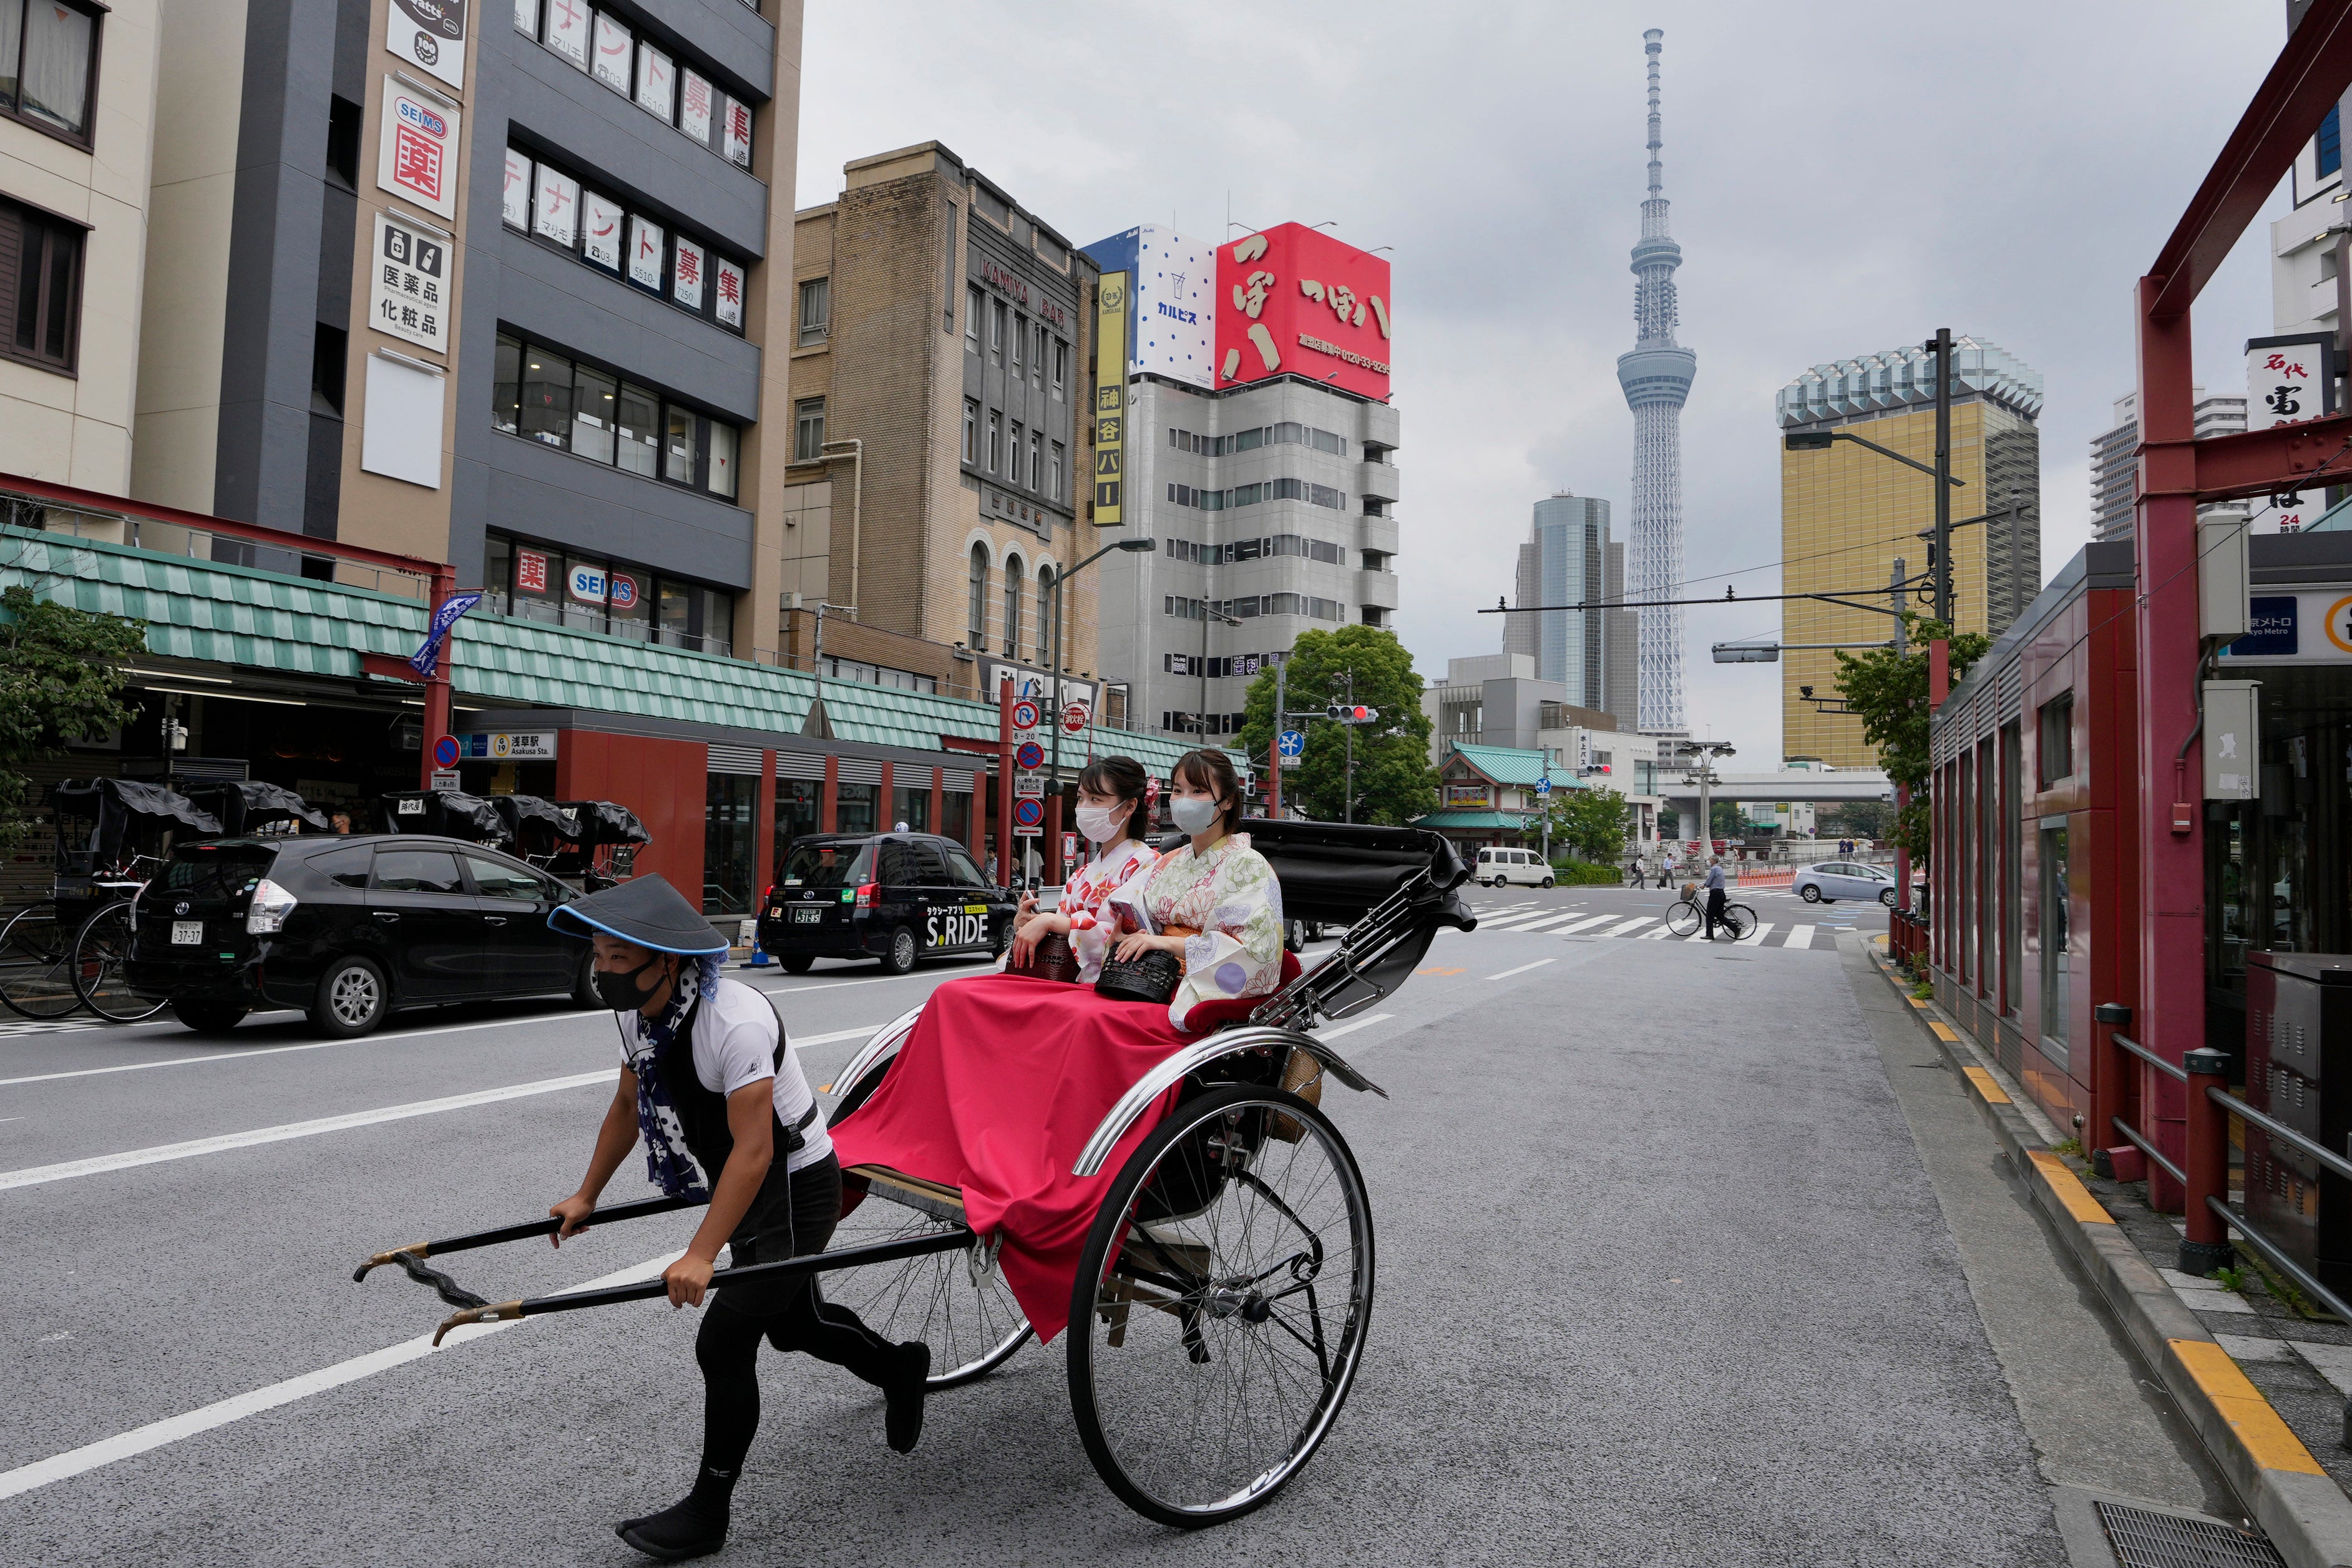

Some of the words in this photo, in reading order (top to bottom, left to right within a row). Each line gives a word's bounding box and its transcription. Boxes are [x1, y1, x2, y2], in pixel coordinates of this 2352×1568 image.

[445, 22, 457, 32] with
[418, 37, 436, 54] 100
[424, 55, 437, 64] SHOP
[552, 35, 581, 59] マリモ
[684, 118, 705, 140] 7250
[401, 104, 441, 132] SEIMS
[399, 133, 437, 193] 薬
[384, 265, 438, 303] 医薬品
[542, 220, 568, 241] マリモ
[635, 267, 655, 283] 5510-
[677, 286, 693, 302] 7250
[720, 307, 736, 324] 山崎
[384, 285, 422, 305] Pharmaceutical
[423, 303, 437, 311] agent
[982, 259, 1028, 304] KAMIYA
[1040, 298, 1064, 329] BAR
[1220, 234, 1281, 380] つぼ八
[381, 298, 436, 336] 化粧品
[1158, 301, 1196, 326] カルピス
[1299, 279, 1390, 339] つぼ八
[394, 324, 411, 335] Beauty
[1298, 333, 1341, 358] 加盟店募集中
[1342, 348, 1390, 374] 0120-33-9295
[2263, 354, 2308, 379] 名代
[1098, 388, 1120, 504] 神谷バー
[2280, 515, 2300, 525] 24
[521, 555, 544, 588] 薬
[576, 573, 632, 601] SEIMS
[2250, 618, 2291, 627] 京メトロ
[1233, 658, 1259, 676] 歯科
[1065, 714, 1084, 724] 消火栓
[511, 736, 539, 747] 浅草駅
[801, 914, 819, 922] 31-85
[927, 905, 963, 916] タクシーアプリ
[926, 914, 988, 947] S.RIDE
